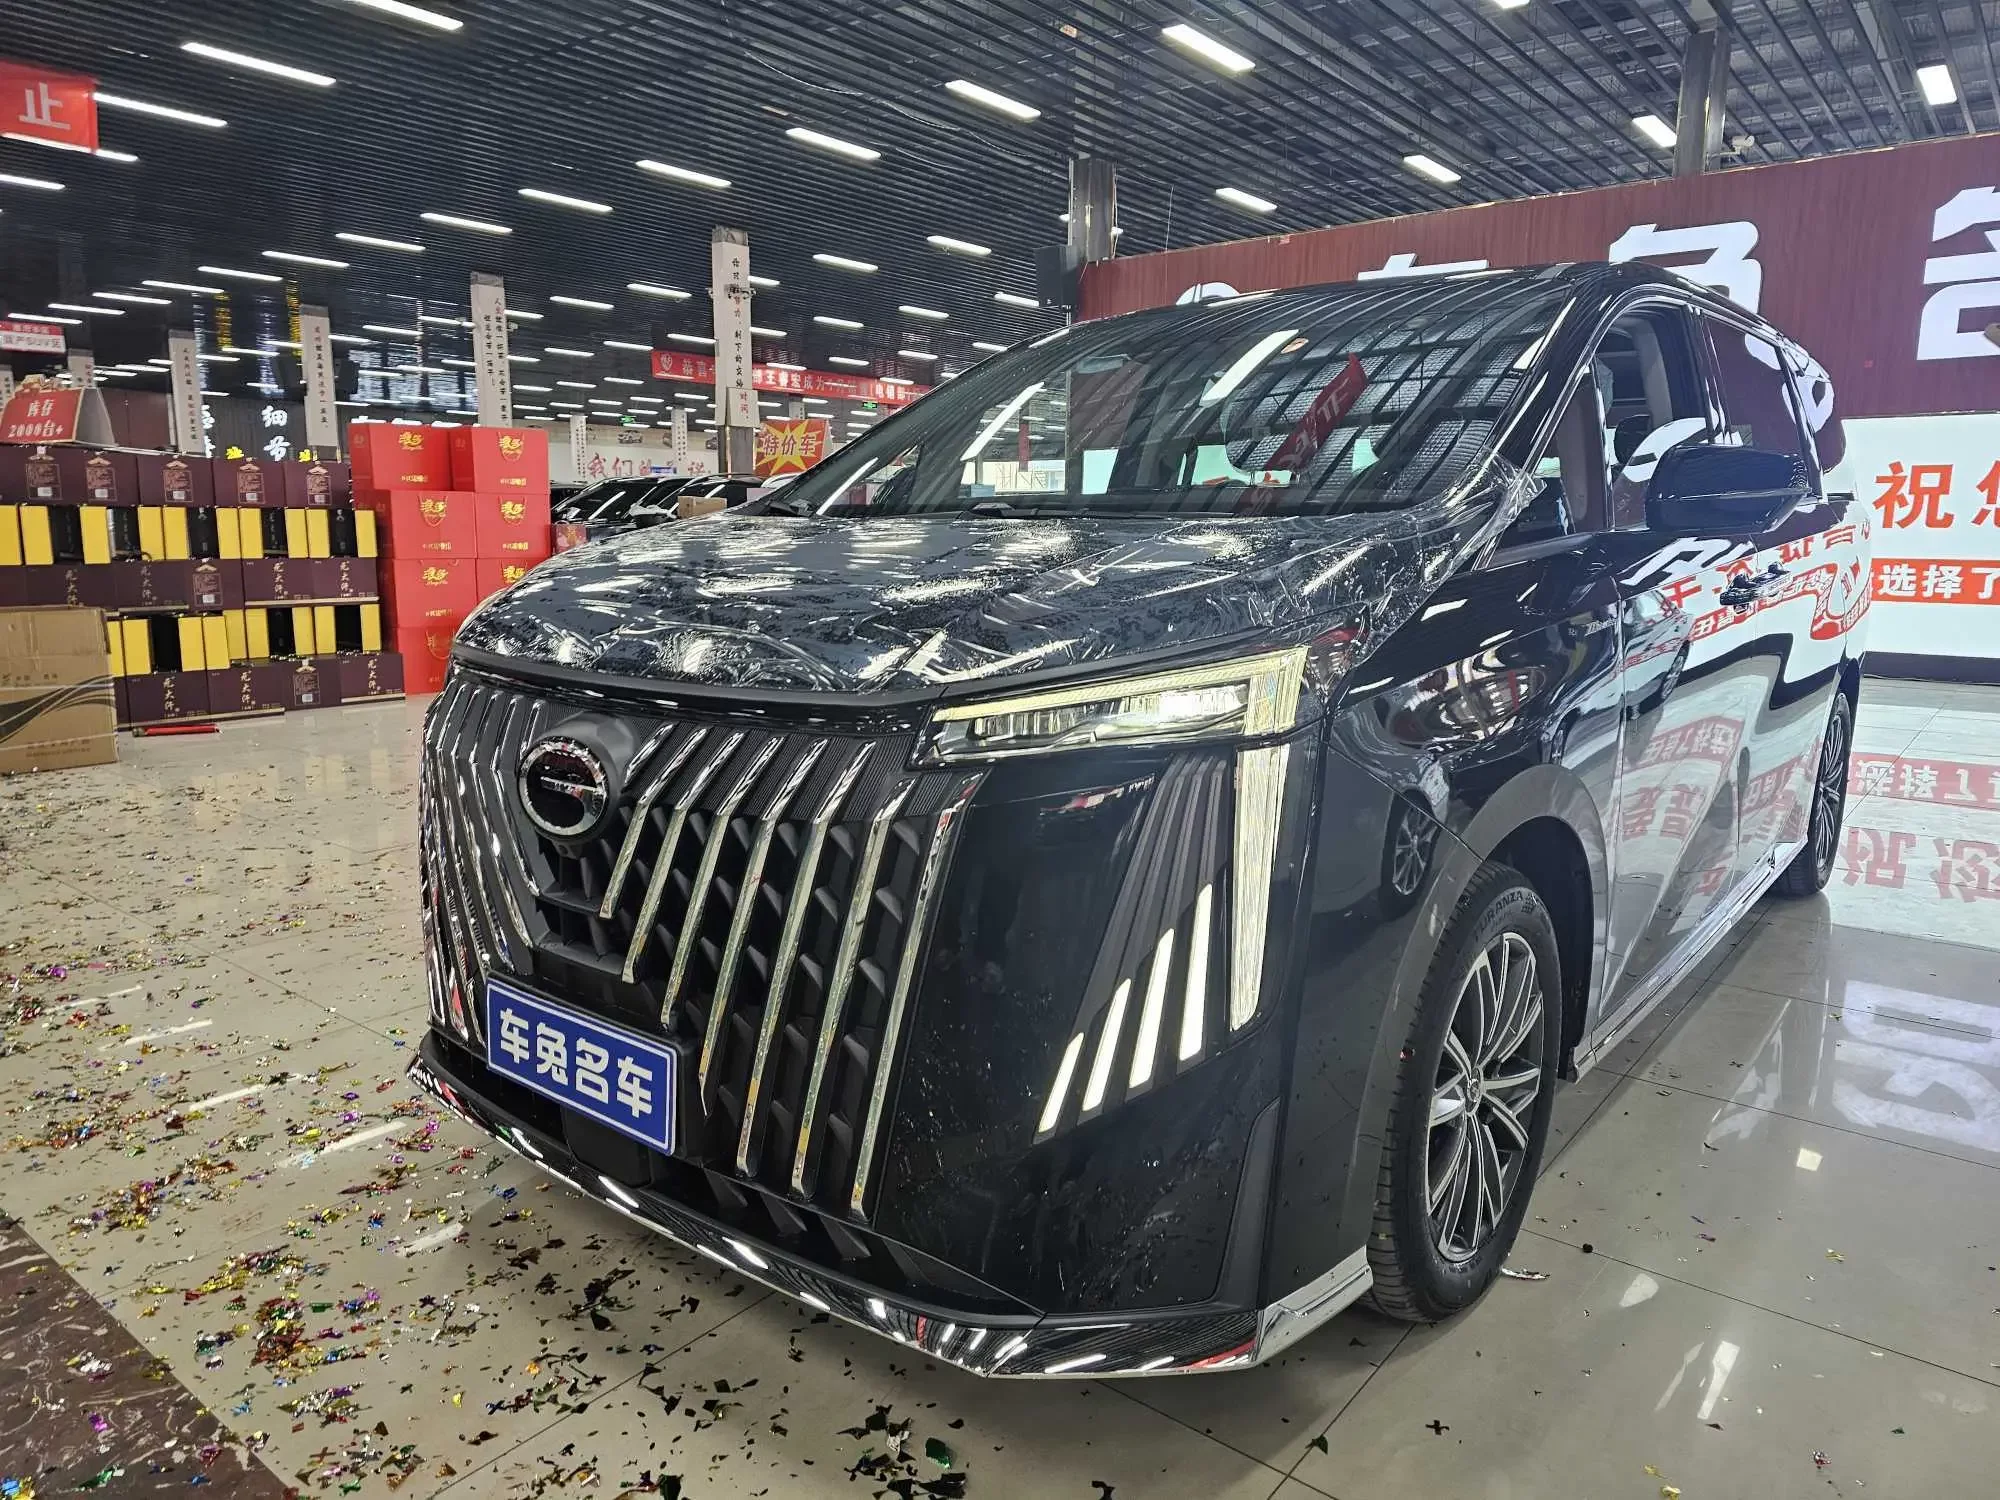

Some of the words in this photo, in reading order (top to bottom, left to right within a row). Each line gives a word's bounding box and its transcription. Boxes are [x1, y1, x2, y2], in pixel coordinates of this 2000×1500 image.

[762, 434, 817, 457] 特价车
[1878, 564, 2000, 599] 选择了
[500, 1008, 653, 1118] 车兔名车
